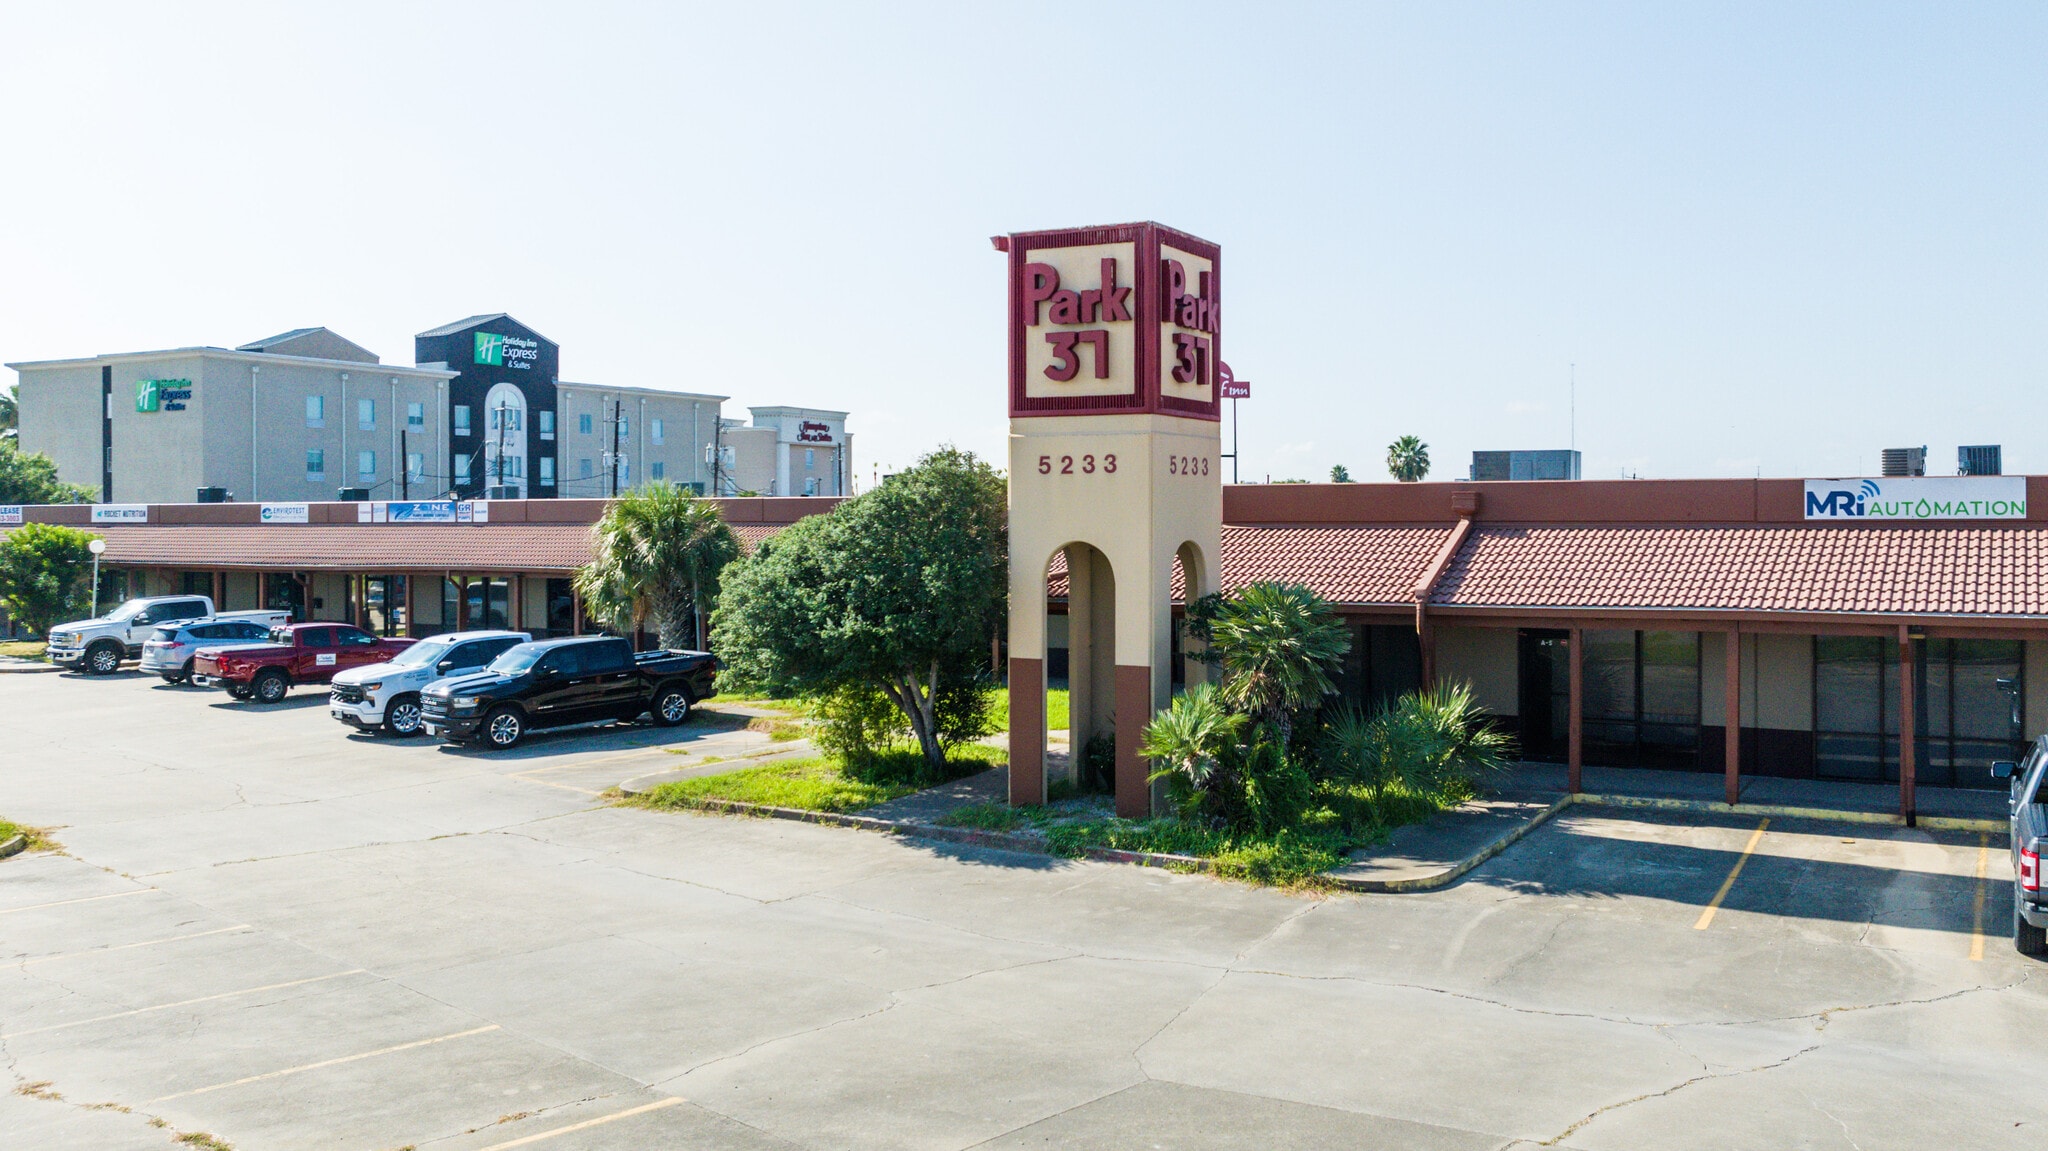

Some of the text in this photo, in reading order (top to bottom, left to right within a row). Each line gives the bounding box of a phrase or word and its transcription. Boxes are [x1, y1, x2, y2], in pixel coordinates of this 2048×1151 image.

[1025, 257, 1133, 326] Park
[1162, 258, 1219, 334] Park
[502, 335, 538, 348] Holiday Inn
[502, 345, 538, 359] Express
[1043, 329, 1109, 382] 37
[1171, 333, 1210, 384] 37
[513, 361, 531, 370] Suites
[160, 389, 192, 402] Express
[1038, 453, 1117, 475] 5233
[1169, 454, 1209, 477] 5233
[1, 507, 20, 515] LEASE
[104, 509, 146, 518] ROCKET NUTRITION
[413, 503, 450, 511] ZONE
[1868, 497, 2025, 518] AUTOMATION
